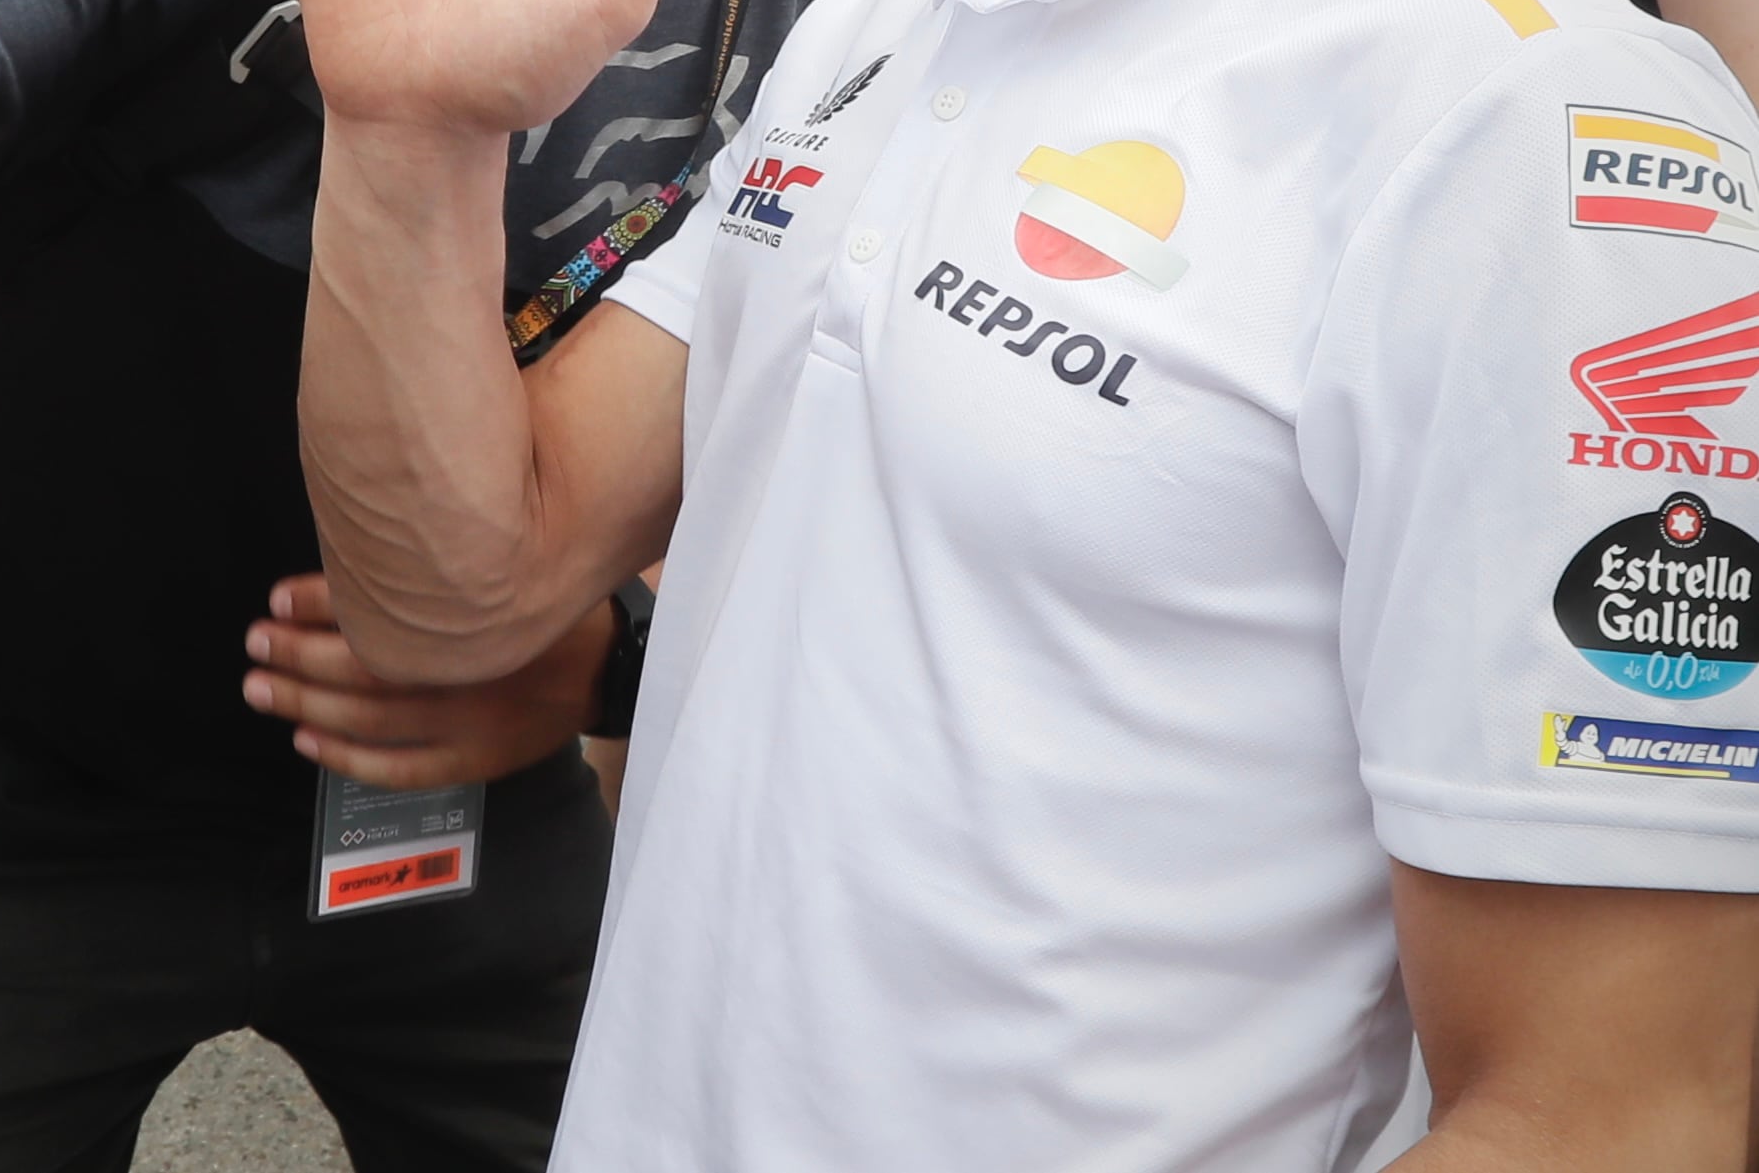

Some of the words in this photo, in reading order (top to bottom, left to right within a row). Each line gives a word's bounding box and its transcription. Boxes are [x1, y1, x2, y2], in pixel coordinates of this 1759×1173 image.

[727, 158, 825, 229] HRC
[1583, 149, 1755, 212] REPSOL
[914, 260, 1137, 407] REPSOL
[1567, 432, 1759, 481] HOND
[1594, 544, 1752, 602] Estrella
[1598, 593, 1738, 650] Galicia
[1646, 651, 1698, 691] 0,0
[1607, 736, 1758, 768] MICHELIN
[339, 873, 392, 894] aramark
